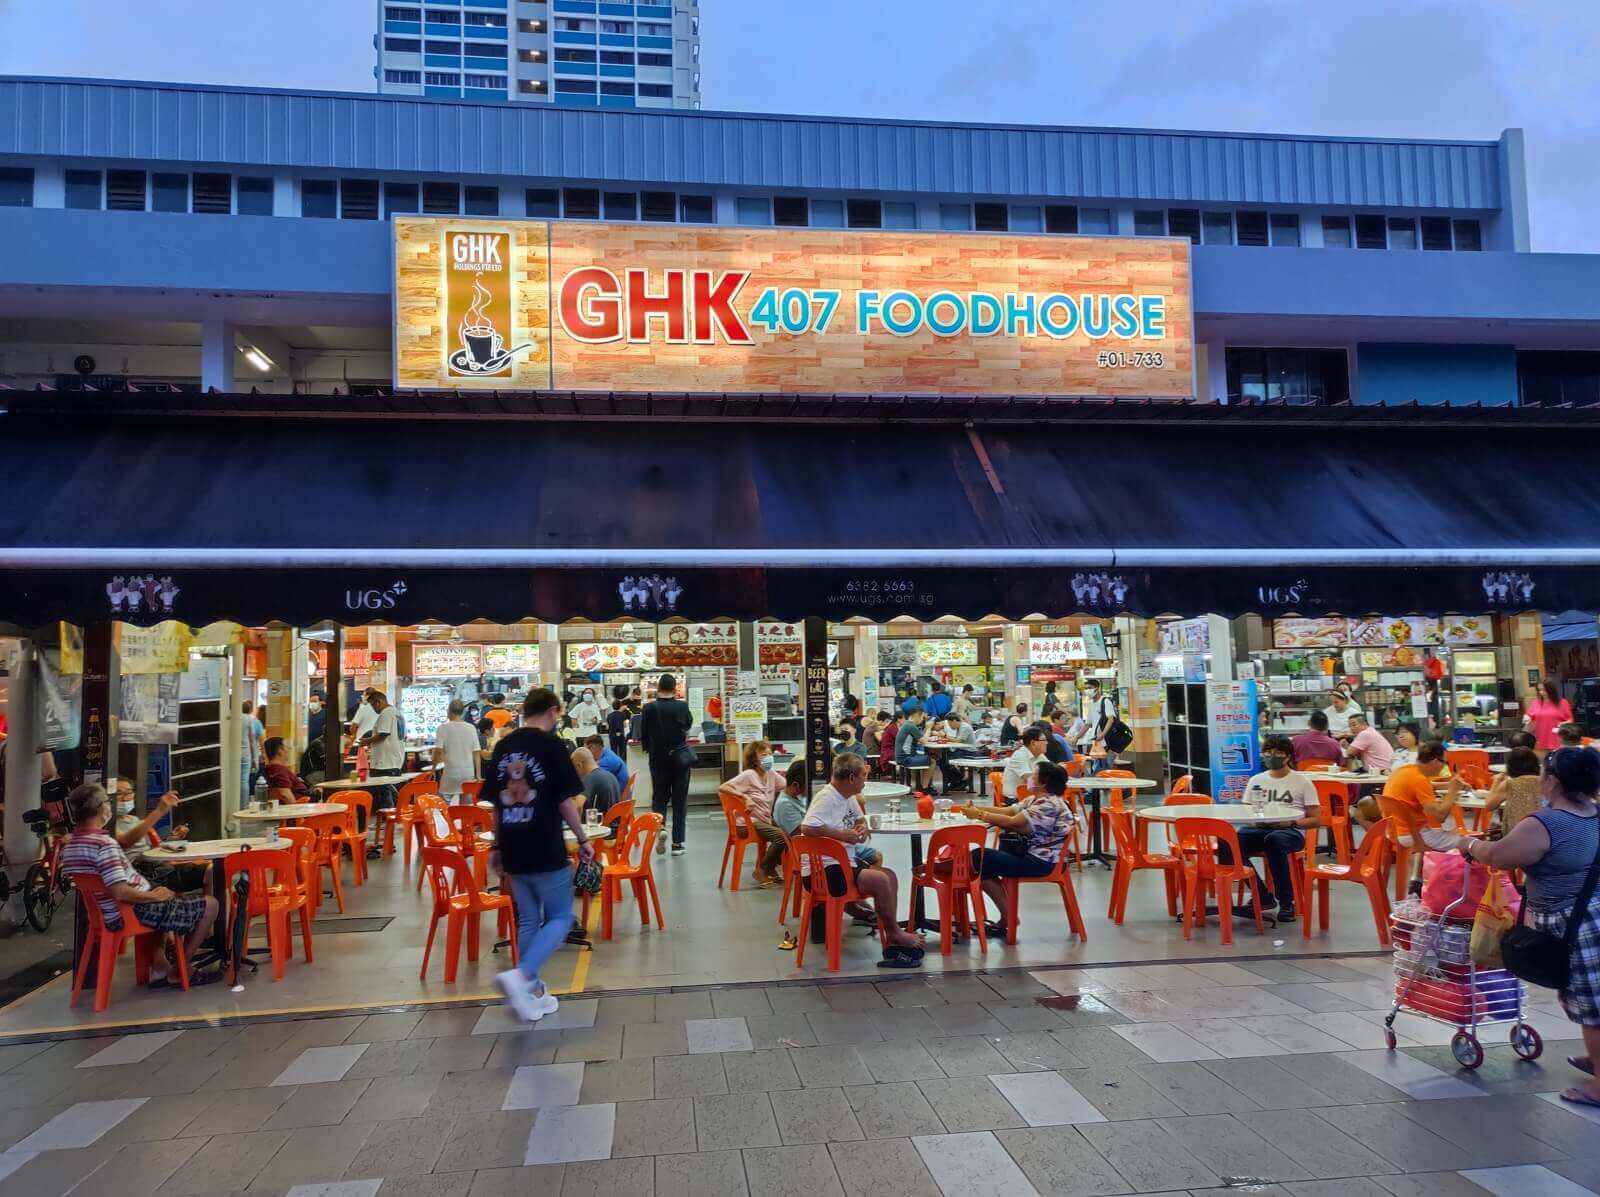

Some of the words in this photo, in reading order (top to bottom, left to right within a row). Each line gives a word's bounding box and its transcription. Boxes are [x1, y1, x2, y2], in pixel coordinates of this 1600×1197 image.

[453, 234, 502, 264] GHK
[454, 263, 482, 271] HOLDINGS
[558, 266, 755, 345] GHK
[751, 287, 841, 335] 407
[856, 288, 1166, 340] FOODHOUSE
[1097, 351, 1164, 368] #01-733
[847, 580, 878, 591] 6382
[1258, 585, 1300, 604] UGS
[345, 590, 396, 609] UGS
[1215, 714, 1250, 723] RETURN
